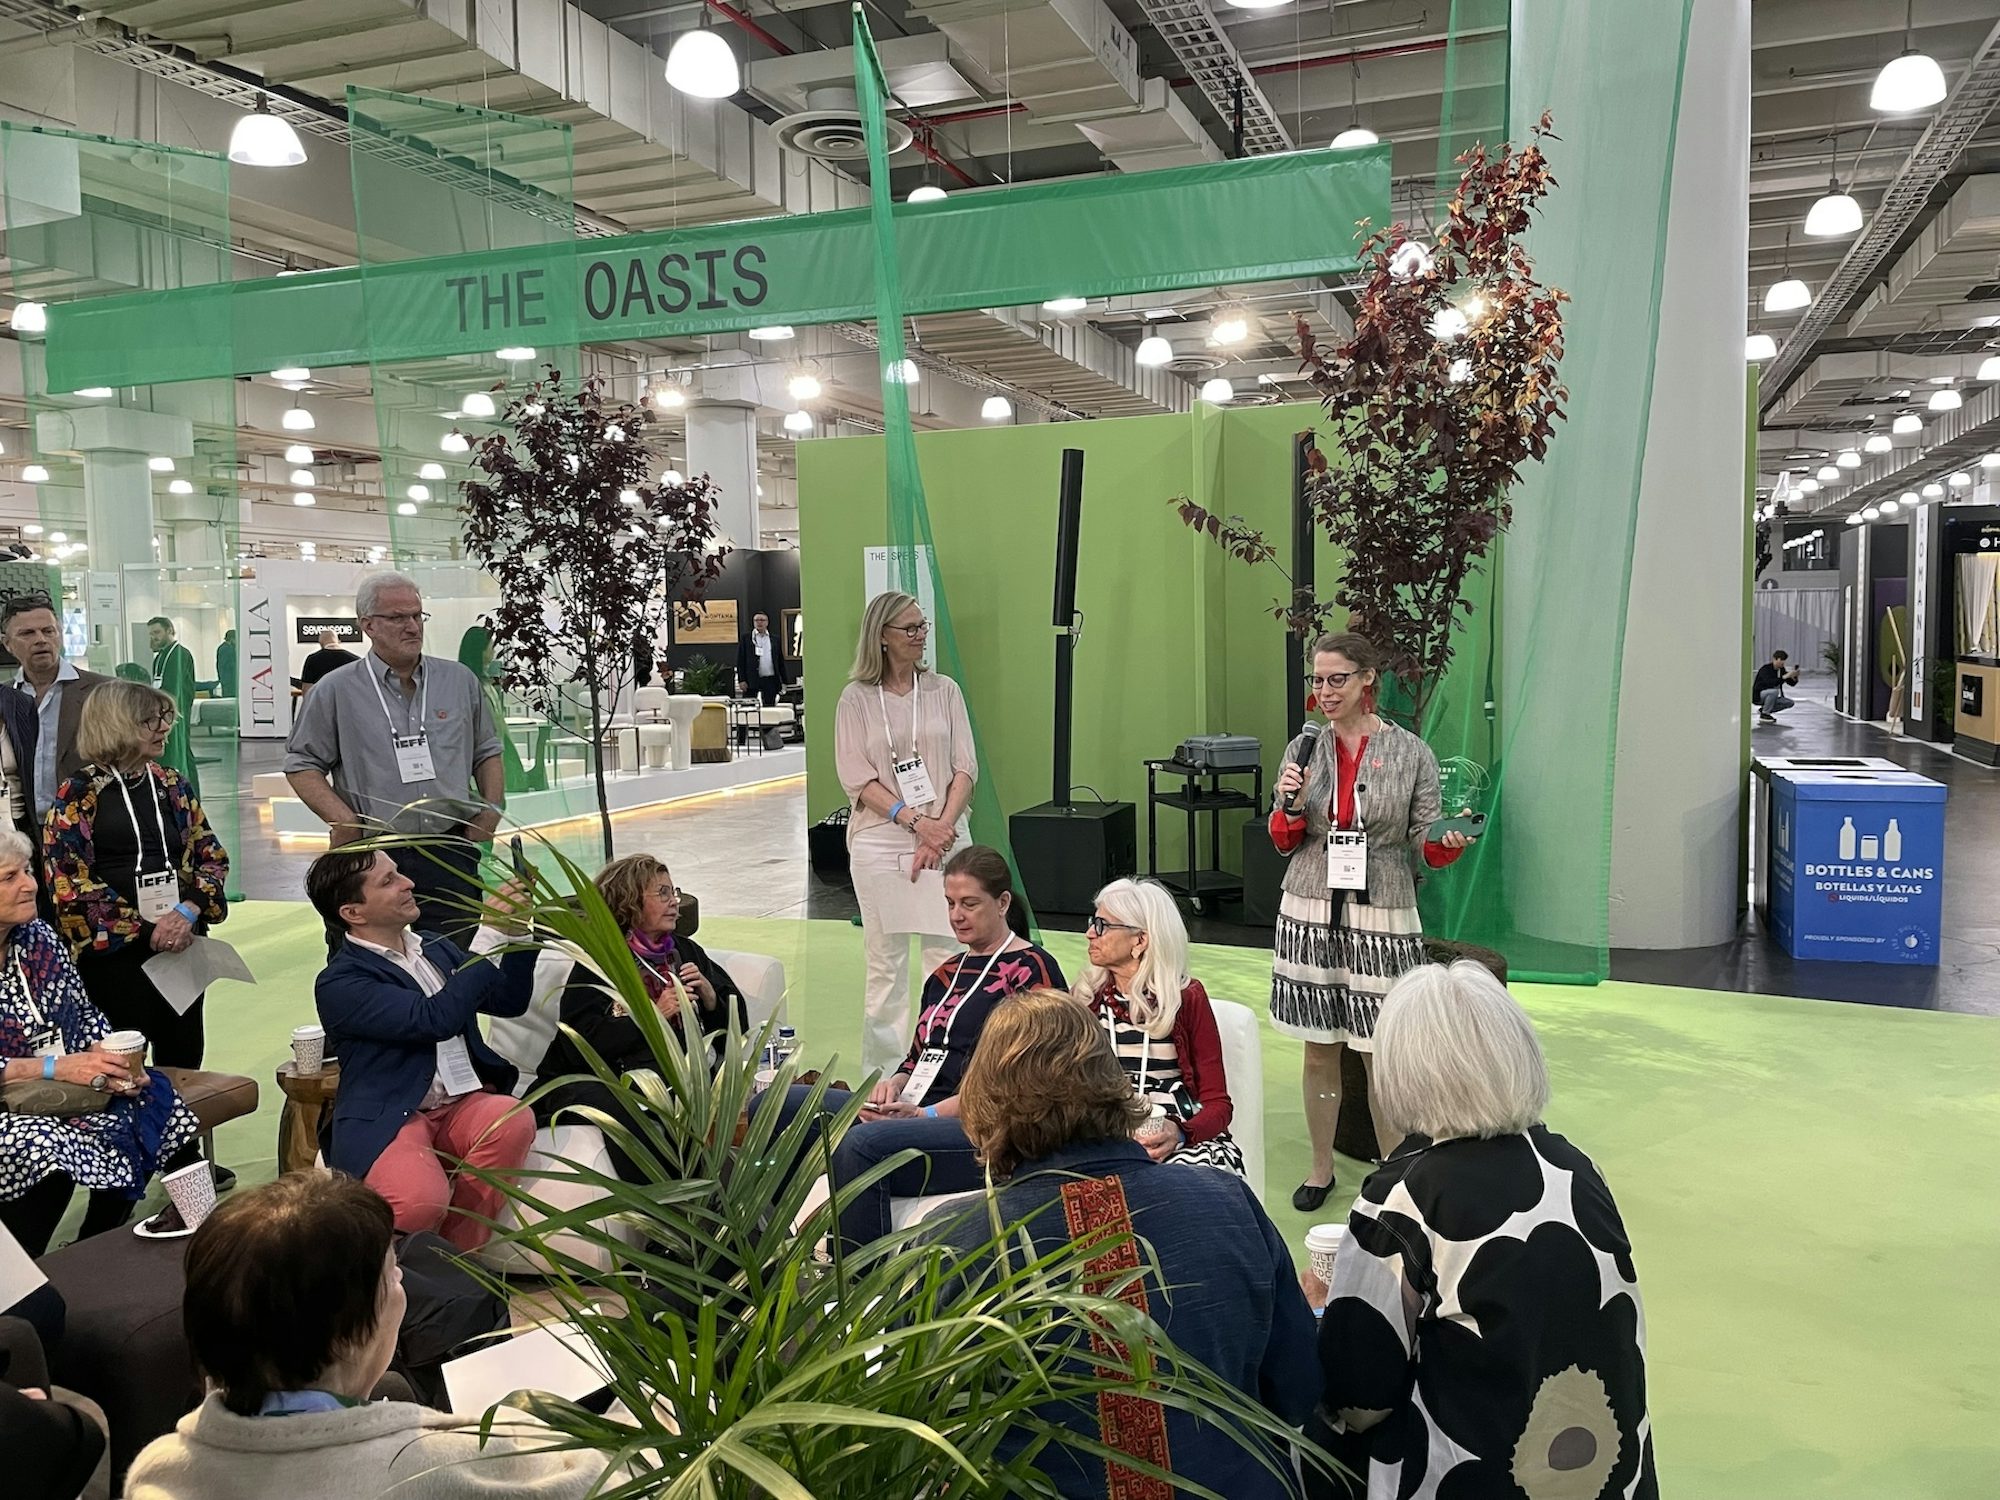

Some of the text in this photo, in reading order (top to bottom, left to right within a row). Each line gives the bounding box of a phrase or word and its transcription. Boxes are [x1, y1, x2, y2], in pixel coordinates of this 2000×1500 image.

[445, 245, 769, 333] THE OASIS
[870, 551, 886, 561] THE
[248, 597, 275, 729] ITALIA
[1329, 835, 1365, 845] ICFF
[1805, 864, 1934, 880] BOTTLES & CANS
[1815, 881, 1922, 895] BOTELLAS Y LATAS
[1804, 934, 1835, 942] PROUDLY
[1835, 935, 1876, 944] SPONSORED
